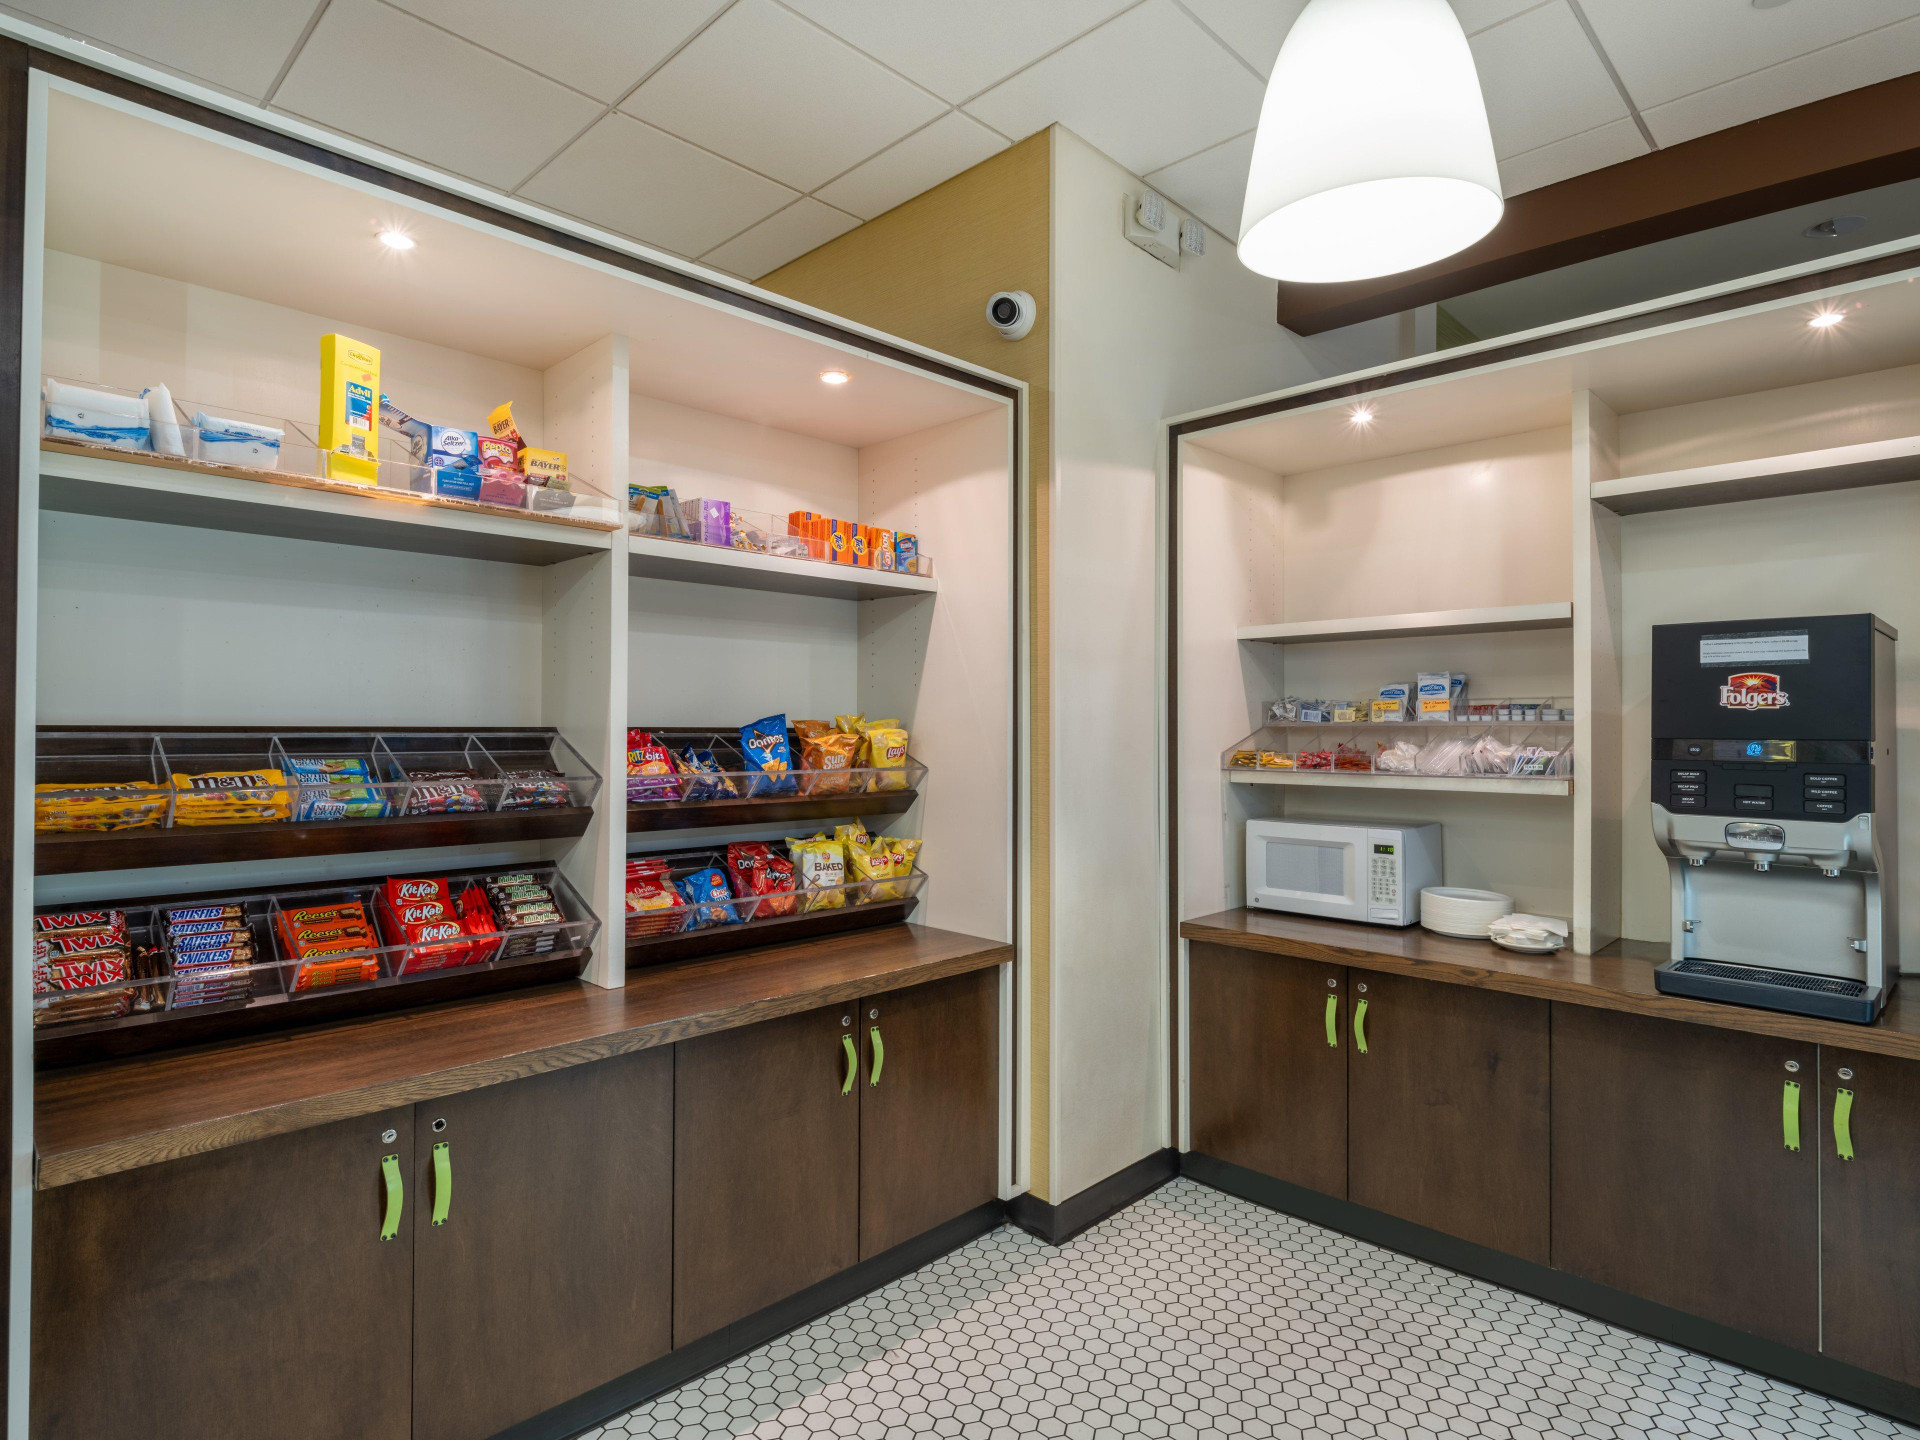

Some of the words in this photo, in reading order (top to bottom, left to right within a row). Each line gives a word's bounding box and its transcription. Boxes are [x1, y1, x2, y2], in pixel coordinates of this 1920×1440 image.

[349, 385, 371, 398] Advil
[493, 419, 509, 434] BAYER
[483, 441, 512, 454] Pepto
[530, 460, 560, 471] BAYER
[1720, 686, 1786, 710] Folgers
[748, 735, 784, 749] Doritos
[628, 750, 645, 762] RITZ
[646, 749, 665, 760] bits
[887, 745, 905, 758] Lay's
[823, 755, 846, 769] Sun
[315, 804, 345, 812] NUTRI
[815, 862, 844, 872] BAKED
[171, 908, 222, 921] SATISFIES
[293, 905, 337, 921] Reese's
[33, 912, 107, 931] TWIX
[171, 922, 222, 935] SATISFIES
[298, 924, 342, 940] Reese's
[50, 933, 124, 954] TWIX
[180, 933, 232, 947] SATISFIES
[36, 939, 46, 960] LEFT
[178, 950, 232, 964] SNICKERS
[53, 959, 124, 979] TWIX
[50, 970, 124, 991] TWIX
